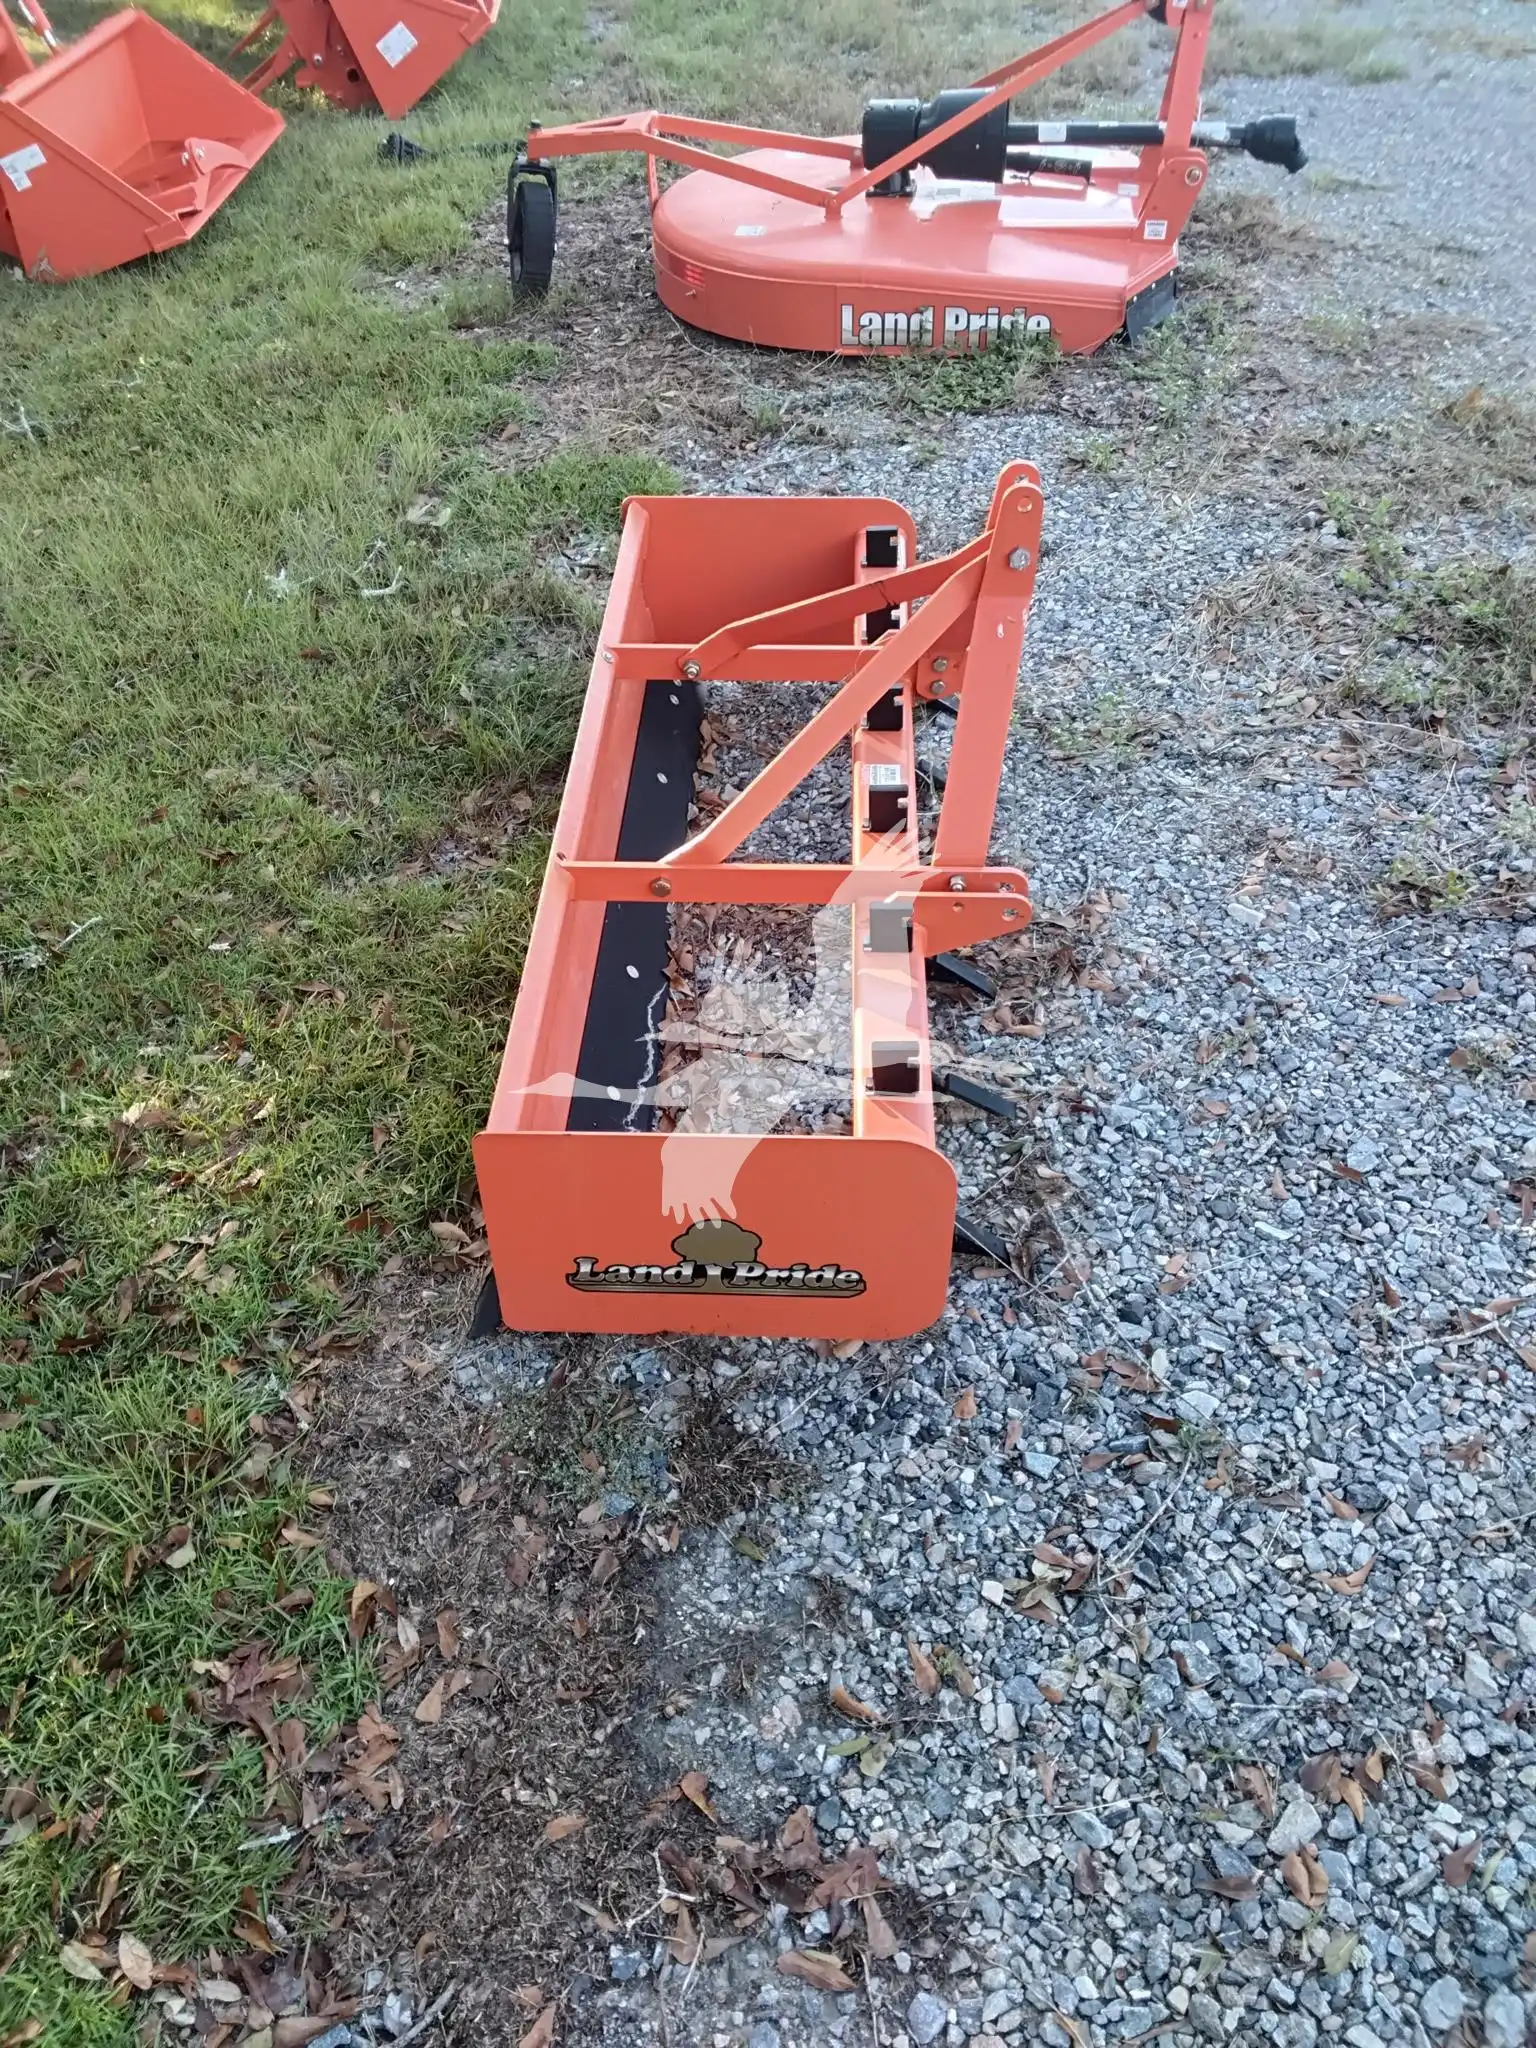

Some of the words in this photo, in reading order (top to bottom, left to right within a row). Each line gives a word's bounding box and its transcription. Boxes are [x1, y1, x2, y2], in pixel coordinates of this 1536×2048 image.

[841, 304, 935, 346] Land
[573, 1257, 697, 1285] Land
[730, 1261, 862, 1289] Pride
